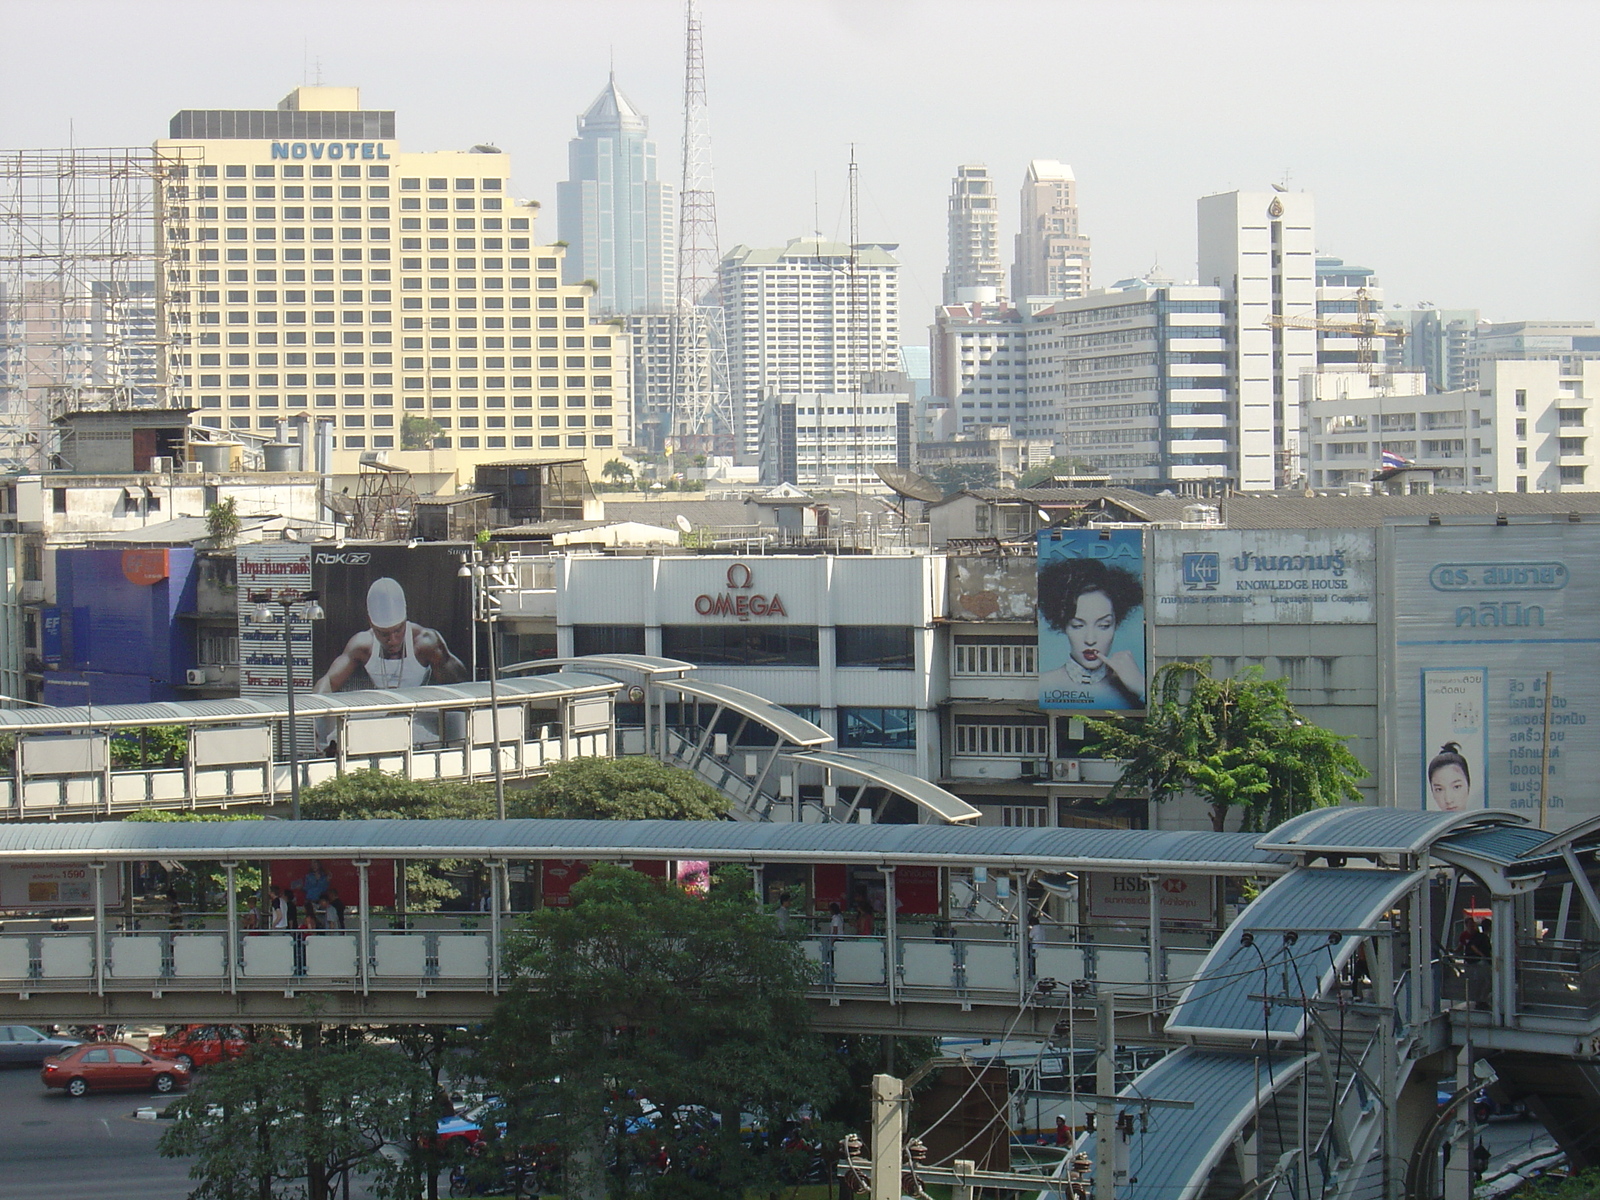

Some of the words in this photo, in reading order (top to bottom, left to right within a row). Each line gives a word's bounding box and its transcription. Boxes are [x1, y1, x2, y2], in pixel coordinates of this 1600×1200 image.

[271, 142, 391, 160] NOVOTEL
[1233, 549, 1346, 576] บ้านความรู้
[1440, 568, 1476, 585] ดร.
[1236, 580, 1308, 590] KNOWLEDGE
[1312, 580, 1348, 590] HOUSE
[695, 592, 788, 620] OMEGA
[1314, 595, 1327, 603] and
[1331, 595, 1369, 605] Computer
[1455, 601, 1546, 627] คลินิก
[45, 617, 60, 628] EF
[1509, 678, 1525, 692] สิว
[1509, 694, 1567, 709] โรคผิวนัง
[1510, 778, 1541, 792] ผมร่ว
[1510, 793, 1564, 808] ลดน้ำนัก
[62, 869, 85, 879] 1590
[1113, 876, 1153, 892] HSB
